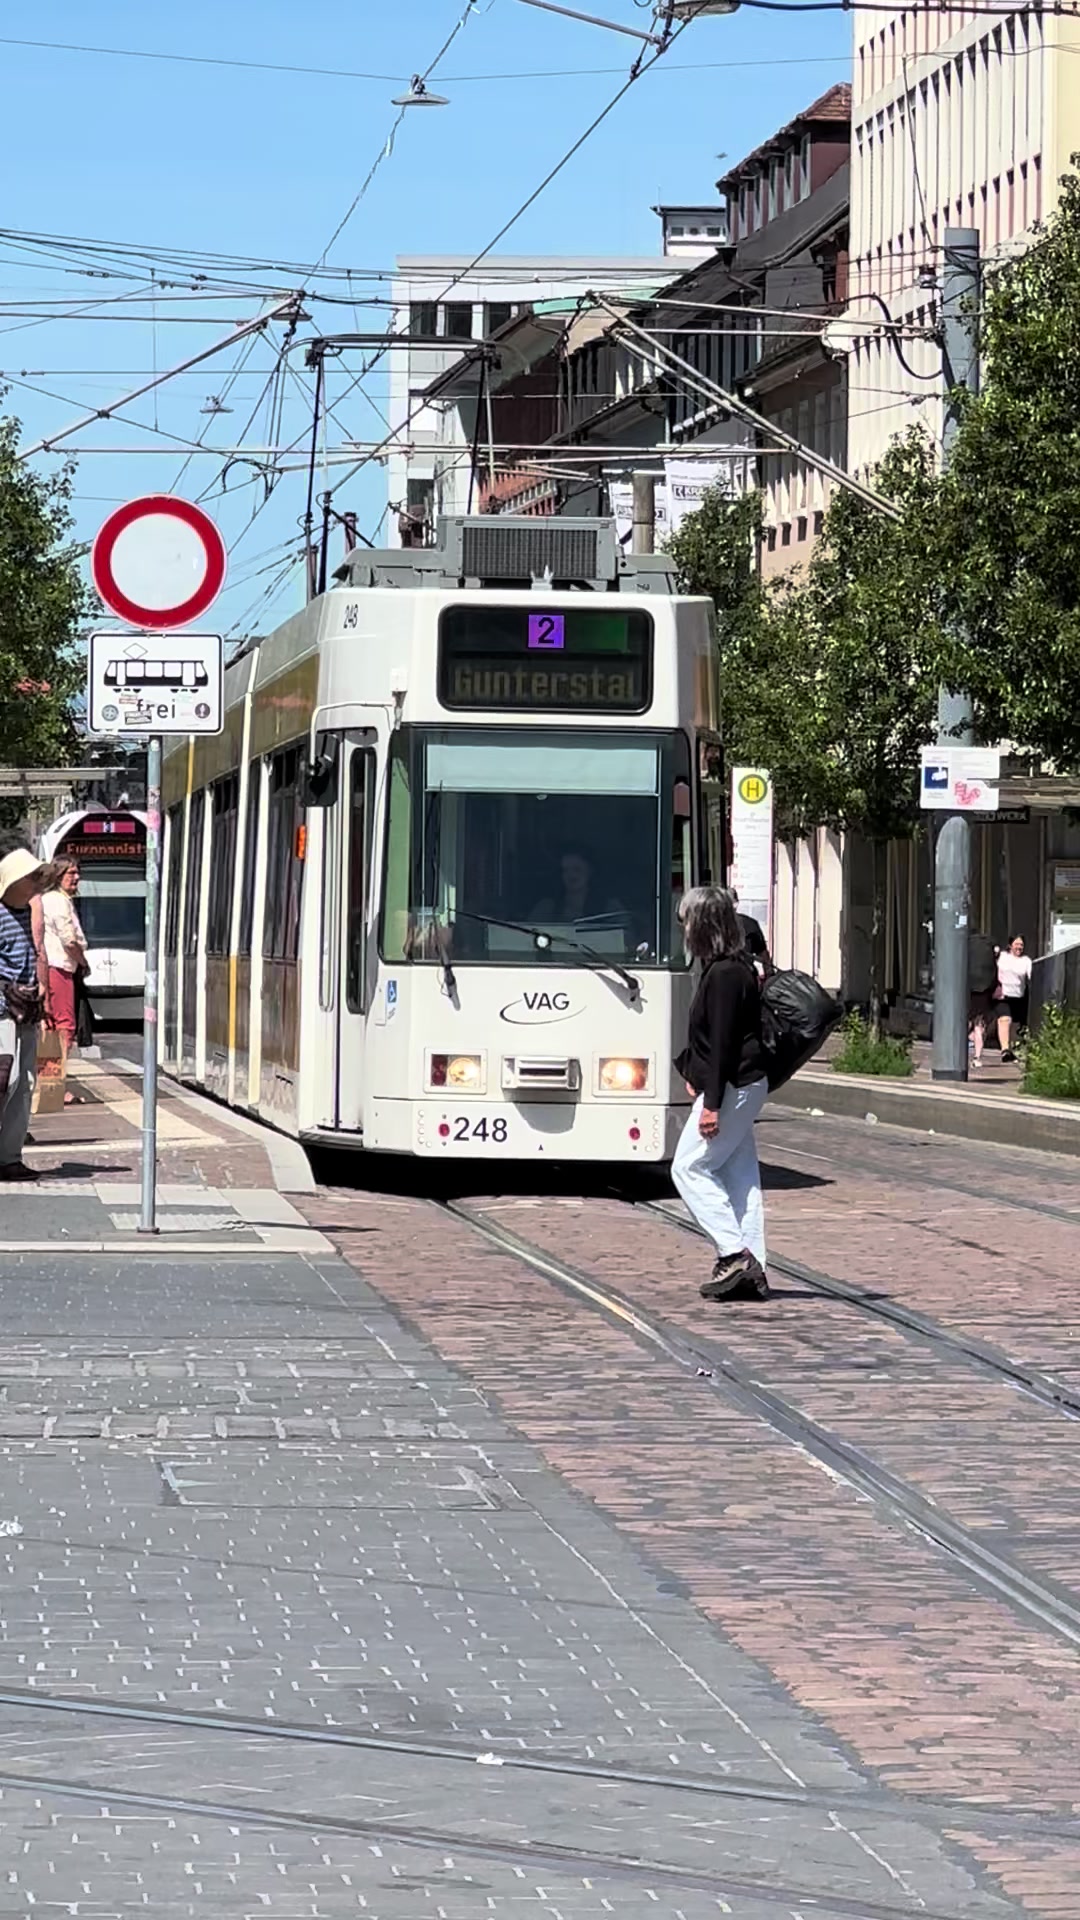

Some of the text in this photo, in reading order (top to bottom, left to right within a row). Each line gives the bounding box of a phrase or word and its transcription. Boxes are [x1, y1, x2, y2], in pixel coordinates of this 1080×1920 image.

[537, 616, 555, 644] 2
[136, 698, 176, 719] frei
[746, 780, 760, 798] H
[522, 991, 571, 1011] VAG
[453, 1116, 508, 1143] 248
